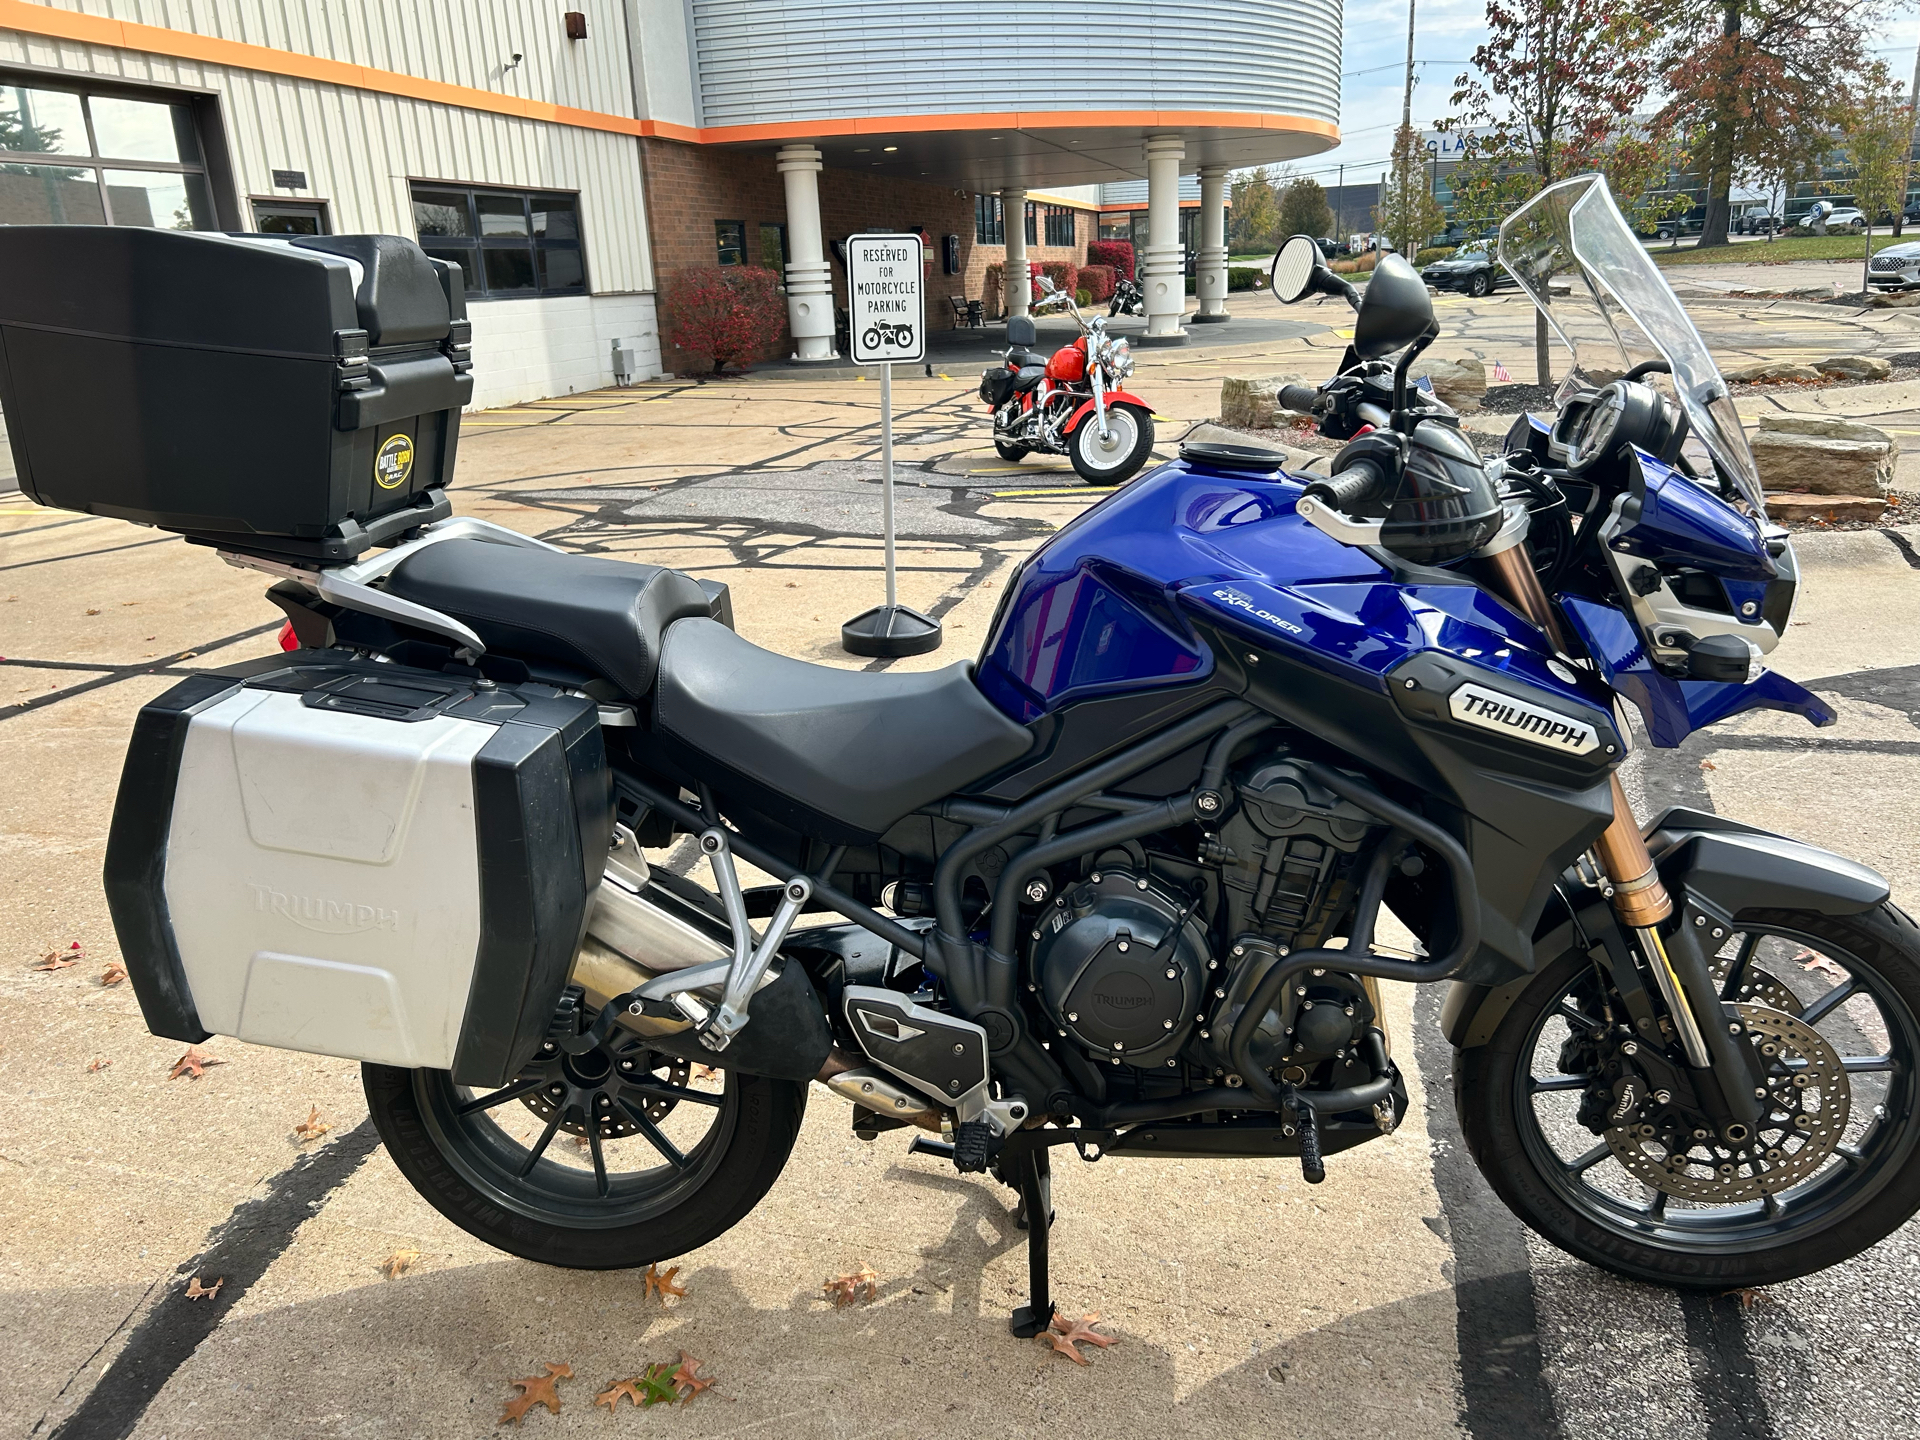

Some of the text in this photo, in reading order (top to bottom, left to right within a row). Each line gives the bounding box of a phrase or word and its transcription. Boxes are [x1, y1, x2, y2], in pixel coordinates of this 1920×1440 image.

[1427, 134, 1519, 153] CLASC
[863, 249, 908, 262] RESERVED
[879, 267, 894, 277] FOR
[857, 282, 916, 295] MOTORCYCLE
[868, 300, 907, 313] PARKING
[379, 452, 398, 470] BATTLE
[1212, 589, 1303, 635] EXPLORER
[1463, 693, 1588, 748] TRIUMPH
[246, 883, 398, 933] TRIUMPH
[1094, 993, 1153, 1008] TRIUMPH
[1612, 1084, 1634, 1120] TRIUMPH
[392, 1109, 505, 1228] MICHELIN
[1536, 1197, 1571, 1226] ROAD
[1581, 1228, 1747, 1277] MICHELIN
